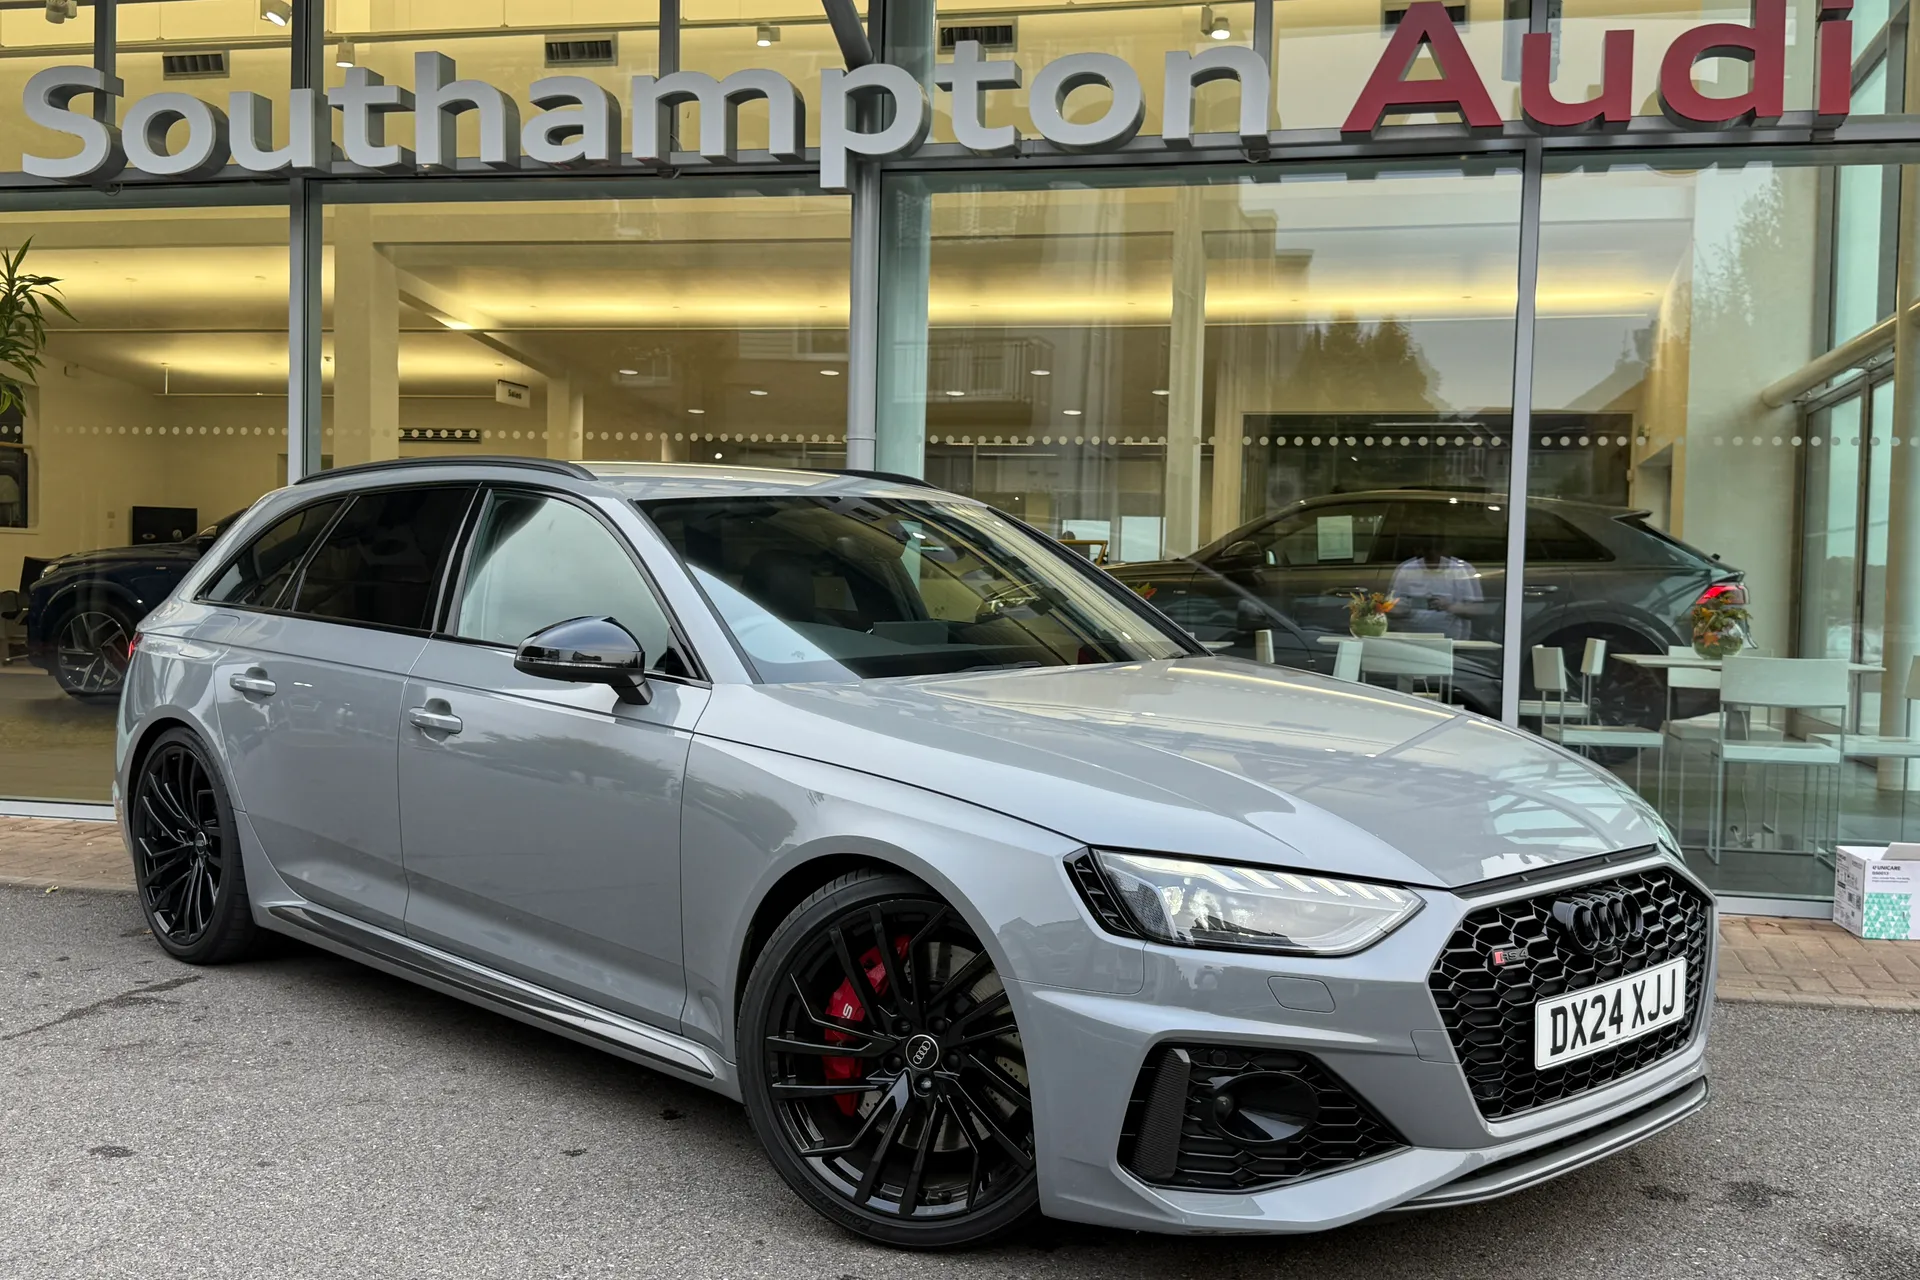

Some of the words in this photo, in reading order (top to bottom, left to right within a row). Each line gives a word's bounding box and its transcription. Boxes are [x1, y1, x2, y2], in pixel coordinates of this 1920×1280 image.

[20, 38, 1272, 190] Southampton
[1339, 0, 1856, 138] Audi
[1500, 950, 1518, 961] RS
[1550, 988, 1623, 1056] DX24
[1632, 968, 1676, 1029] XJJ
